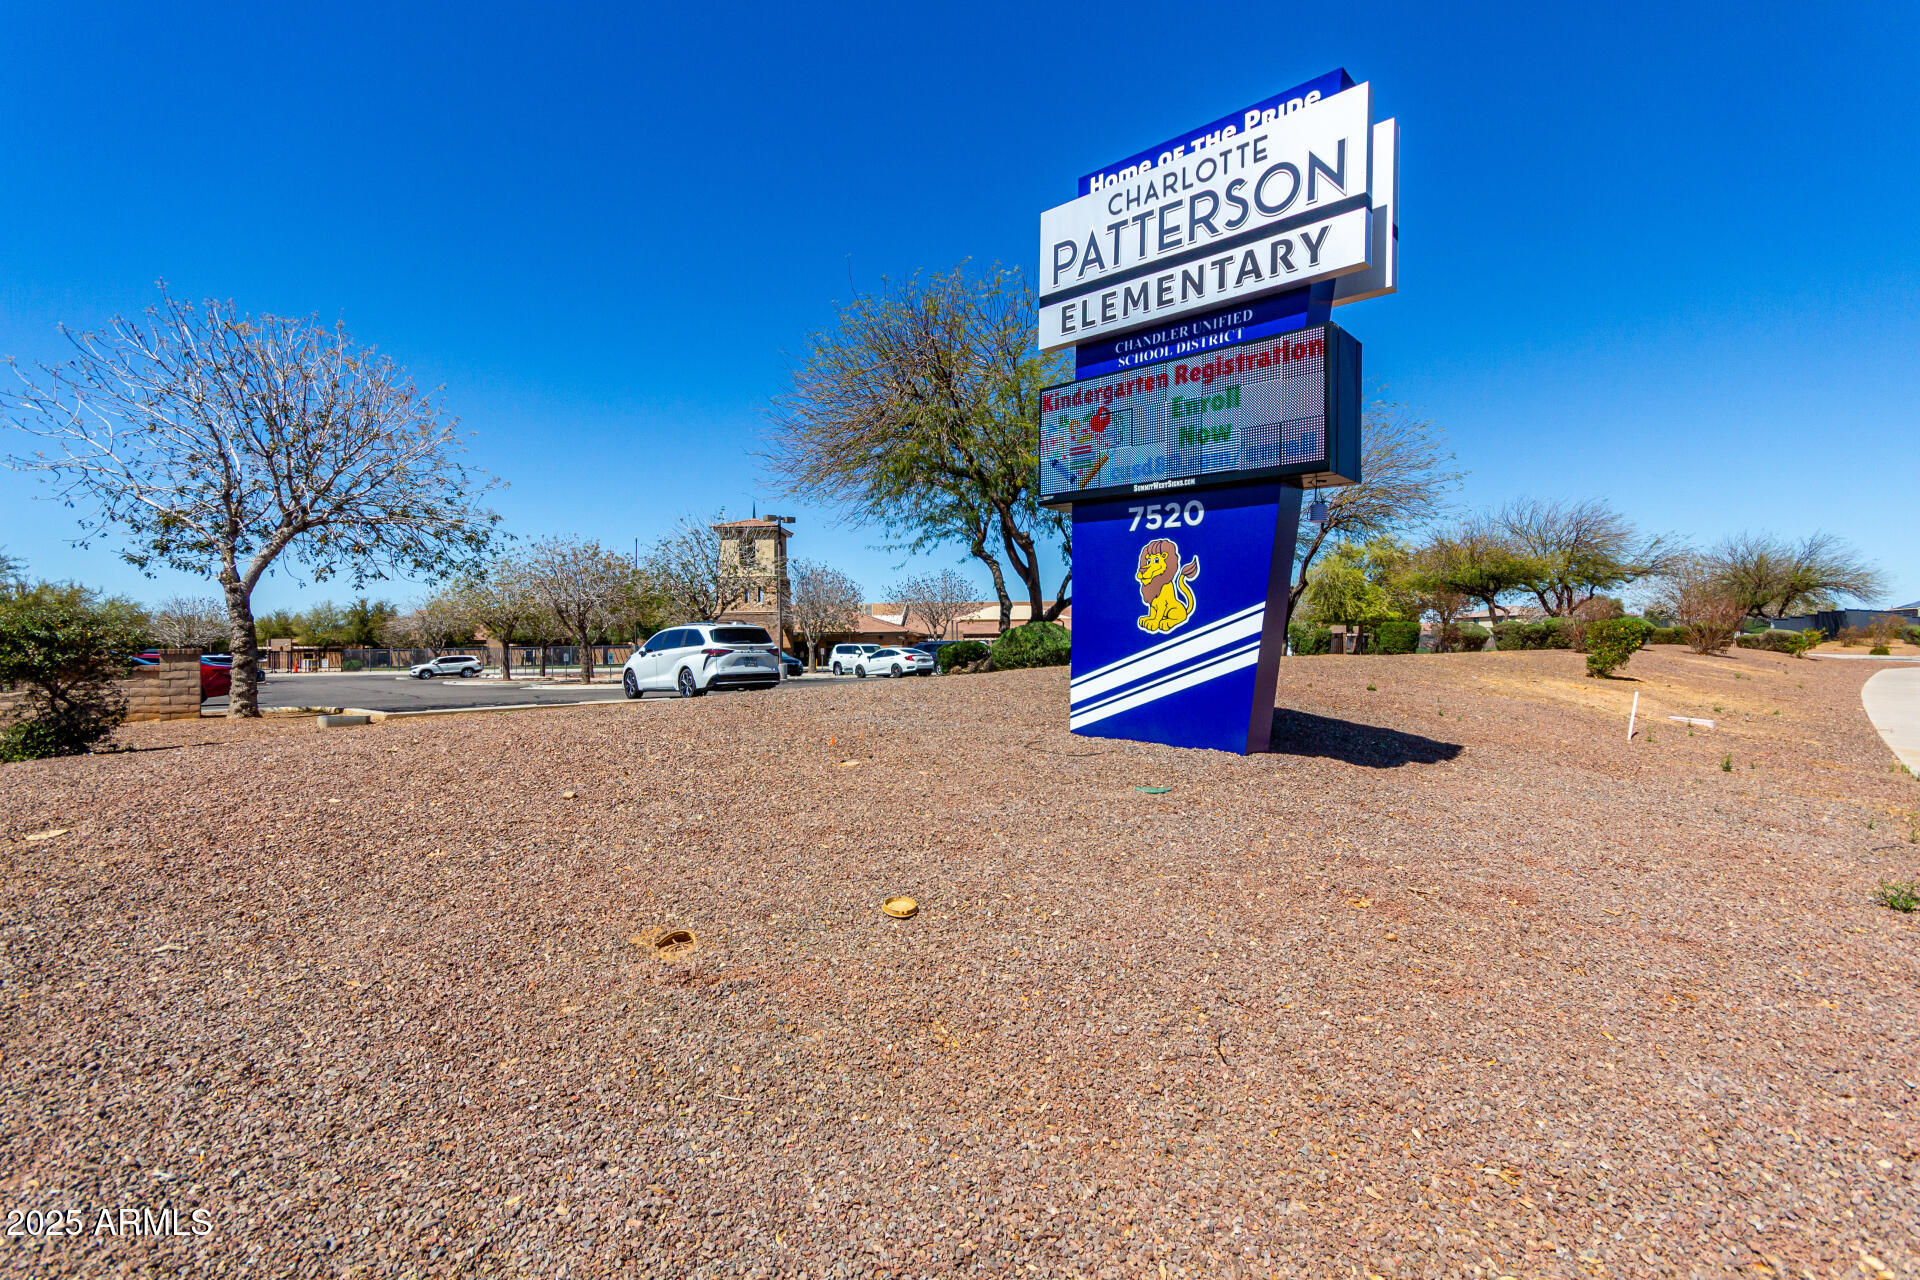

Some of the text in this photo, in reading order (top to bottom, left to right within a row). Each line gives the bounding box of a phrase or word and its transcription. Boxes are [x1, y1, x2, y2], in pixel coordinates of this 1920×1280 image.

[1090, 160, 1152, 194] Home
[1108, 134, 1268, 216] CHARLOTTE
[1052, 136, 1349, 290] PATTERSON
[1060, 225, 1332, 336] ELEMENTARY
[1115, 309, 1253, 354] CHANDLER UNIFIED
[1118, 327, 1244, 368] SCHOOL DISTRICT
[1042, 339, 1325, 413] Kindergarten Registration
[1171, 384, 1241, 419] Enroll
[1179, 423, 1232, 448] Now
[1128, 500, 1205, 532] 7520
